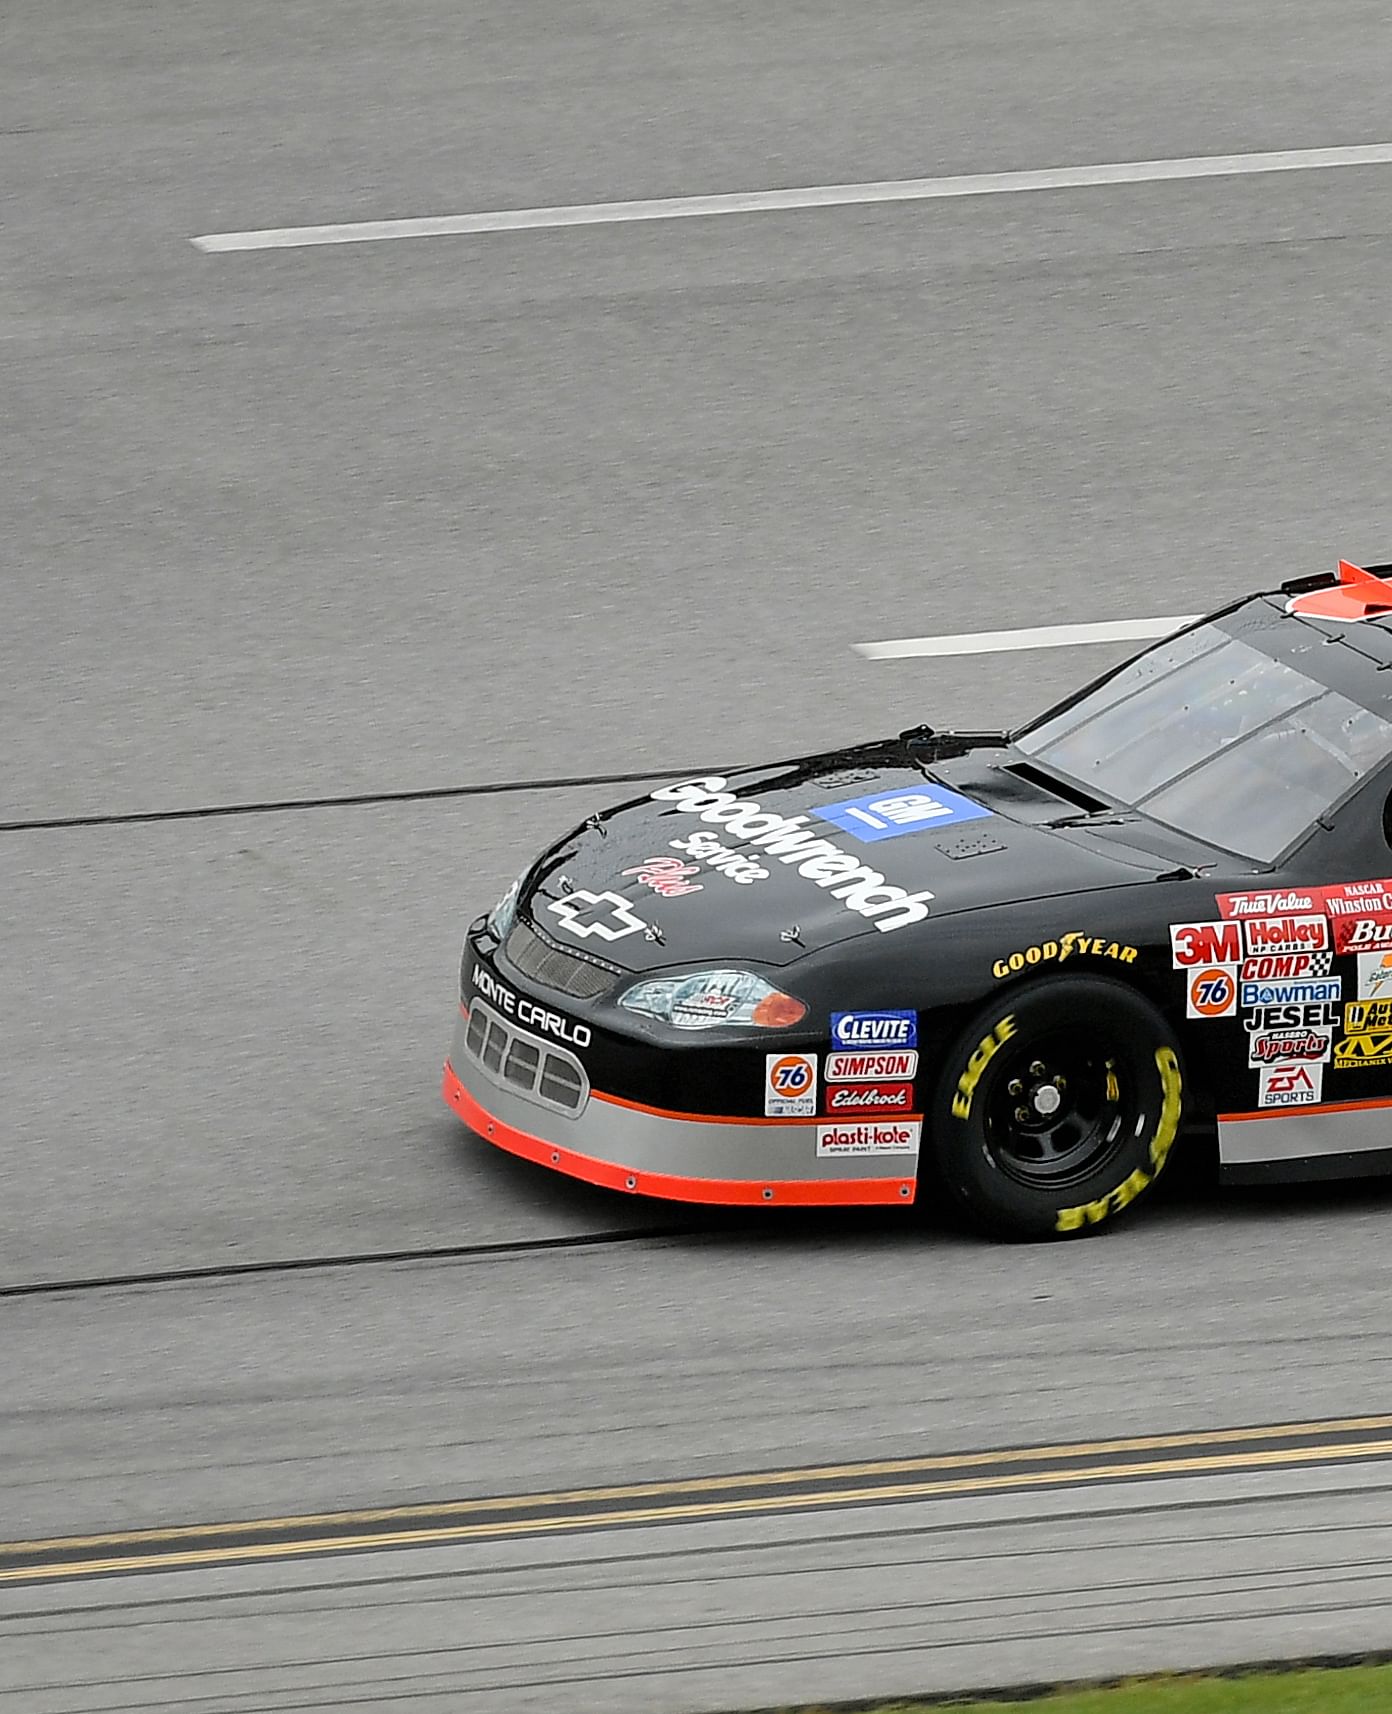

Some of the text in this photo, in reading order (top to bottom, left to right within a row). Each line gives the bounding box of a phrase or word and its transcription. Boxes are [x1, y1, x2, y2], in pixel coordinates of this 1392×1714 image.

[868, 794, 954, 825] GM
[651, 776, 936, 933] Goodwrench
[669, 831, 771, 884] Service
[1345, 883, 1384, 896] NASCAR
[1326, 896, 1382, 915] Winston
[1175, 924, 1241, 965] 3M
[1249, 919, 1325, 949] Holley
[1342, 944, 1372, 953] POLE
[1242, 954, 1309, 980] COMP
[1198, 981, 1229, 1006] 76
[1243, 982, 1340, 1004] Bowman
[472, 964, 592, 1048] MONTE CARLO
[1244, 1004, 1339, 1031] JESEL
[837, 1014, 910, 1040] CLEVITE
[1252, 1033, 1327, 1060] Sports
[832, 1055, 910, 1076] SIMPSON
[1334, 1056, 1386, 1070] MECHANIX
[776, 1064, 807, 1089] 76
[1267, 1065, 1314, 1092] EA
[832, 1089, 906, 1107] Edelbrock
[1265, 1091, 1314, 1105] SPORTS
[822, 1126, 910, 1147] plasti-kote
